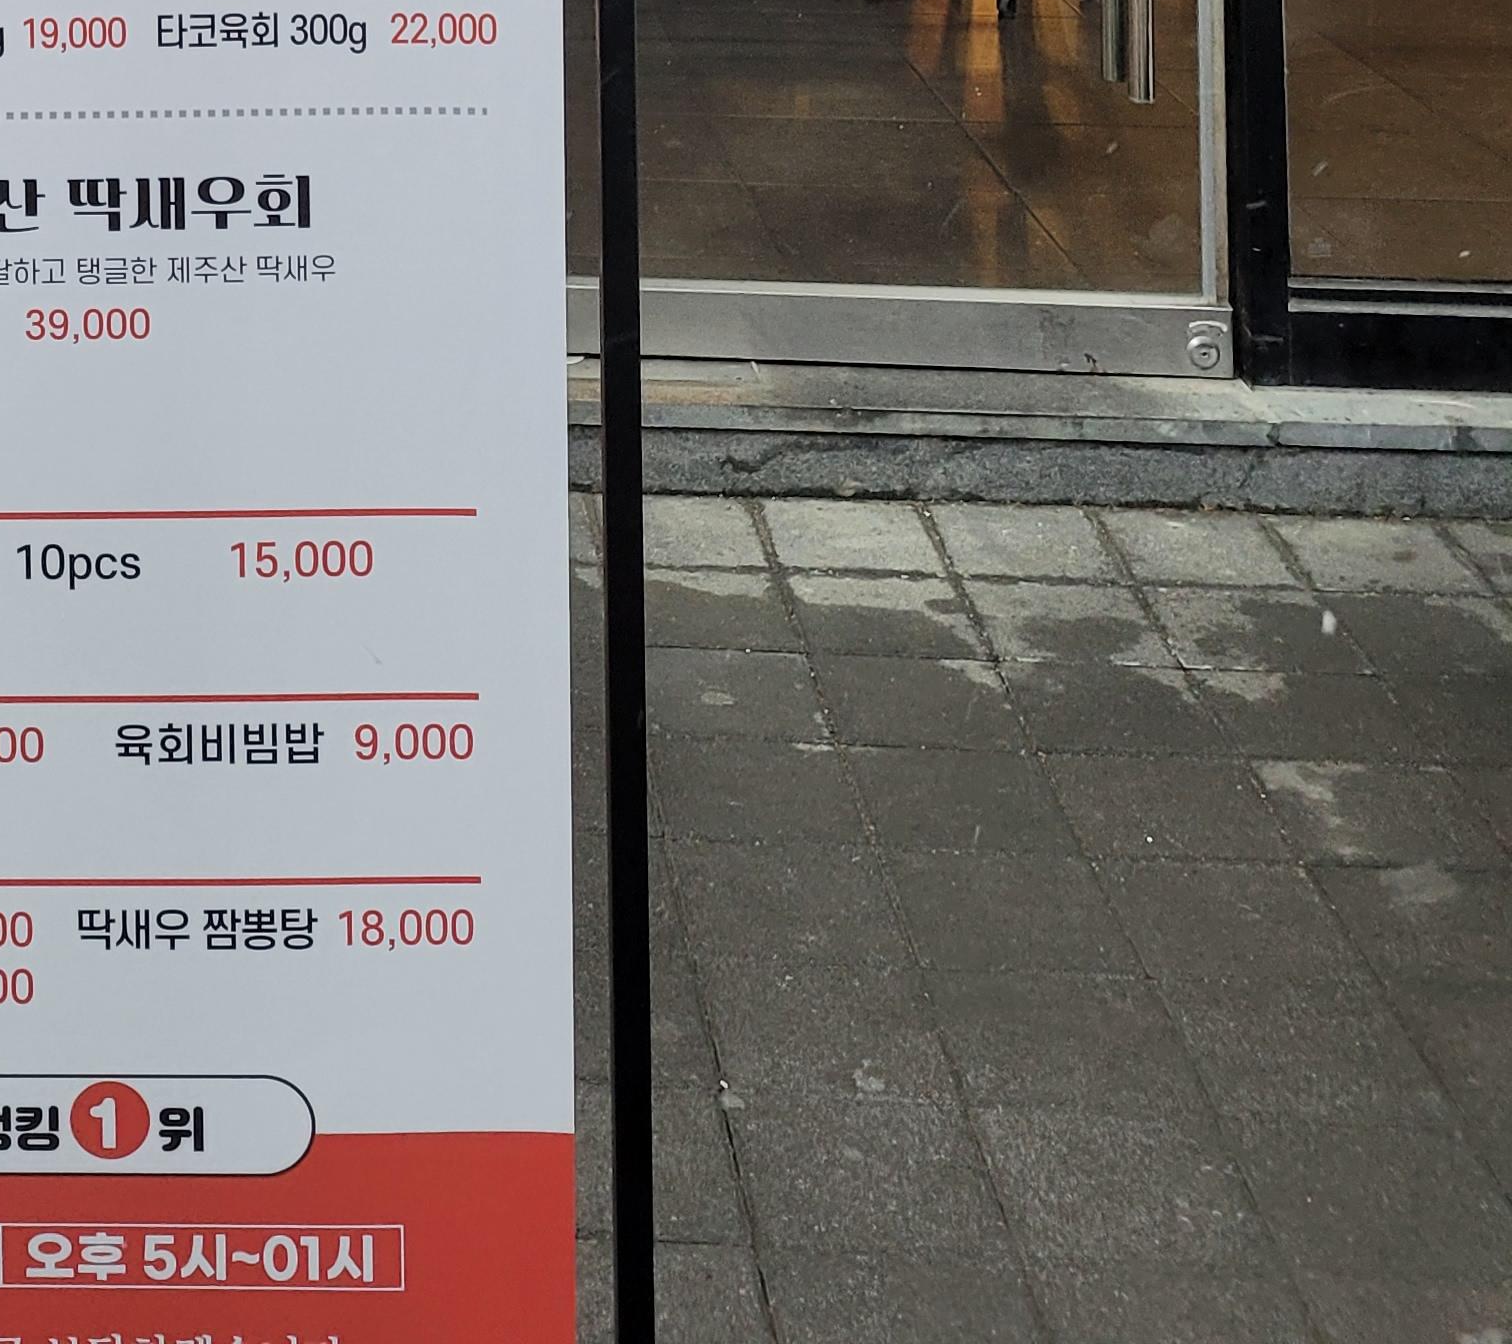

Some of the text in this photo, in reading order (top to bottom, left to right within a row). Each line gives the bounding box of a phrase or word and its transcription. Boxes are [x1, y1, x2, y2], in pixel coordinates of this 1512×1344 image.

[24, 17, 127, 53] 19,000
[158, 12, 278, 49] 타코육회
[291, 14, 366, 54] 300g
[391, 13, 496, 48] 22,000
[67, 175, 310, 231] 딱새우회
[78, 257, 157, 284] 탱글한
[168, 256, 247, 283] 제주산
[257, 255, 335, 282] 딱새우
[26, 308, 151, 344] 39,000
[17, 544, 140, 590] 10pcs
[231, 541, 372, 582] 15,000
[116, 723, 324, 765] 육회비빔밥
[355, 723, 473, 765] 9,000
[78, 909, 190, 950] 딱새우
[203, 909, 318, 950] 짬뽕탕
[339, 909, 473, 951] 18,000
[159, 1106, 204, 1152] 위
[24, 1232, 127, 1281] 오후
[142, 1233, 374, 1283] 5시~01시
